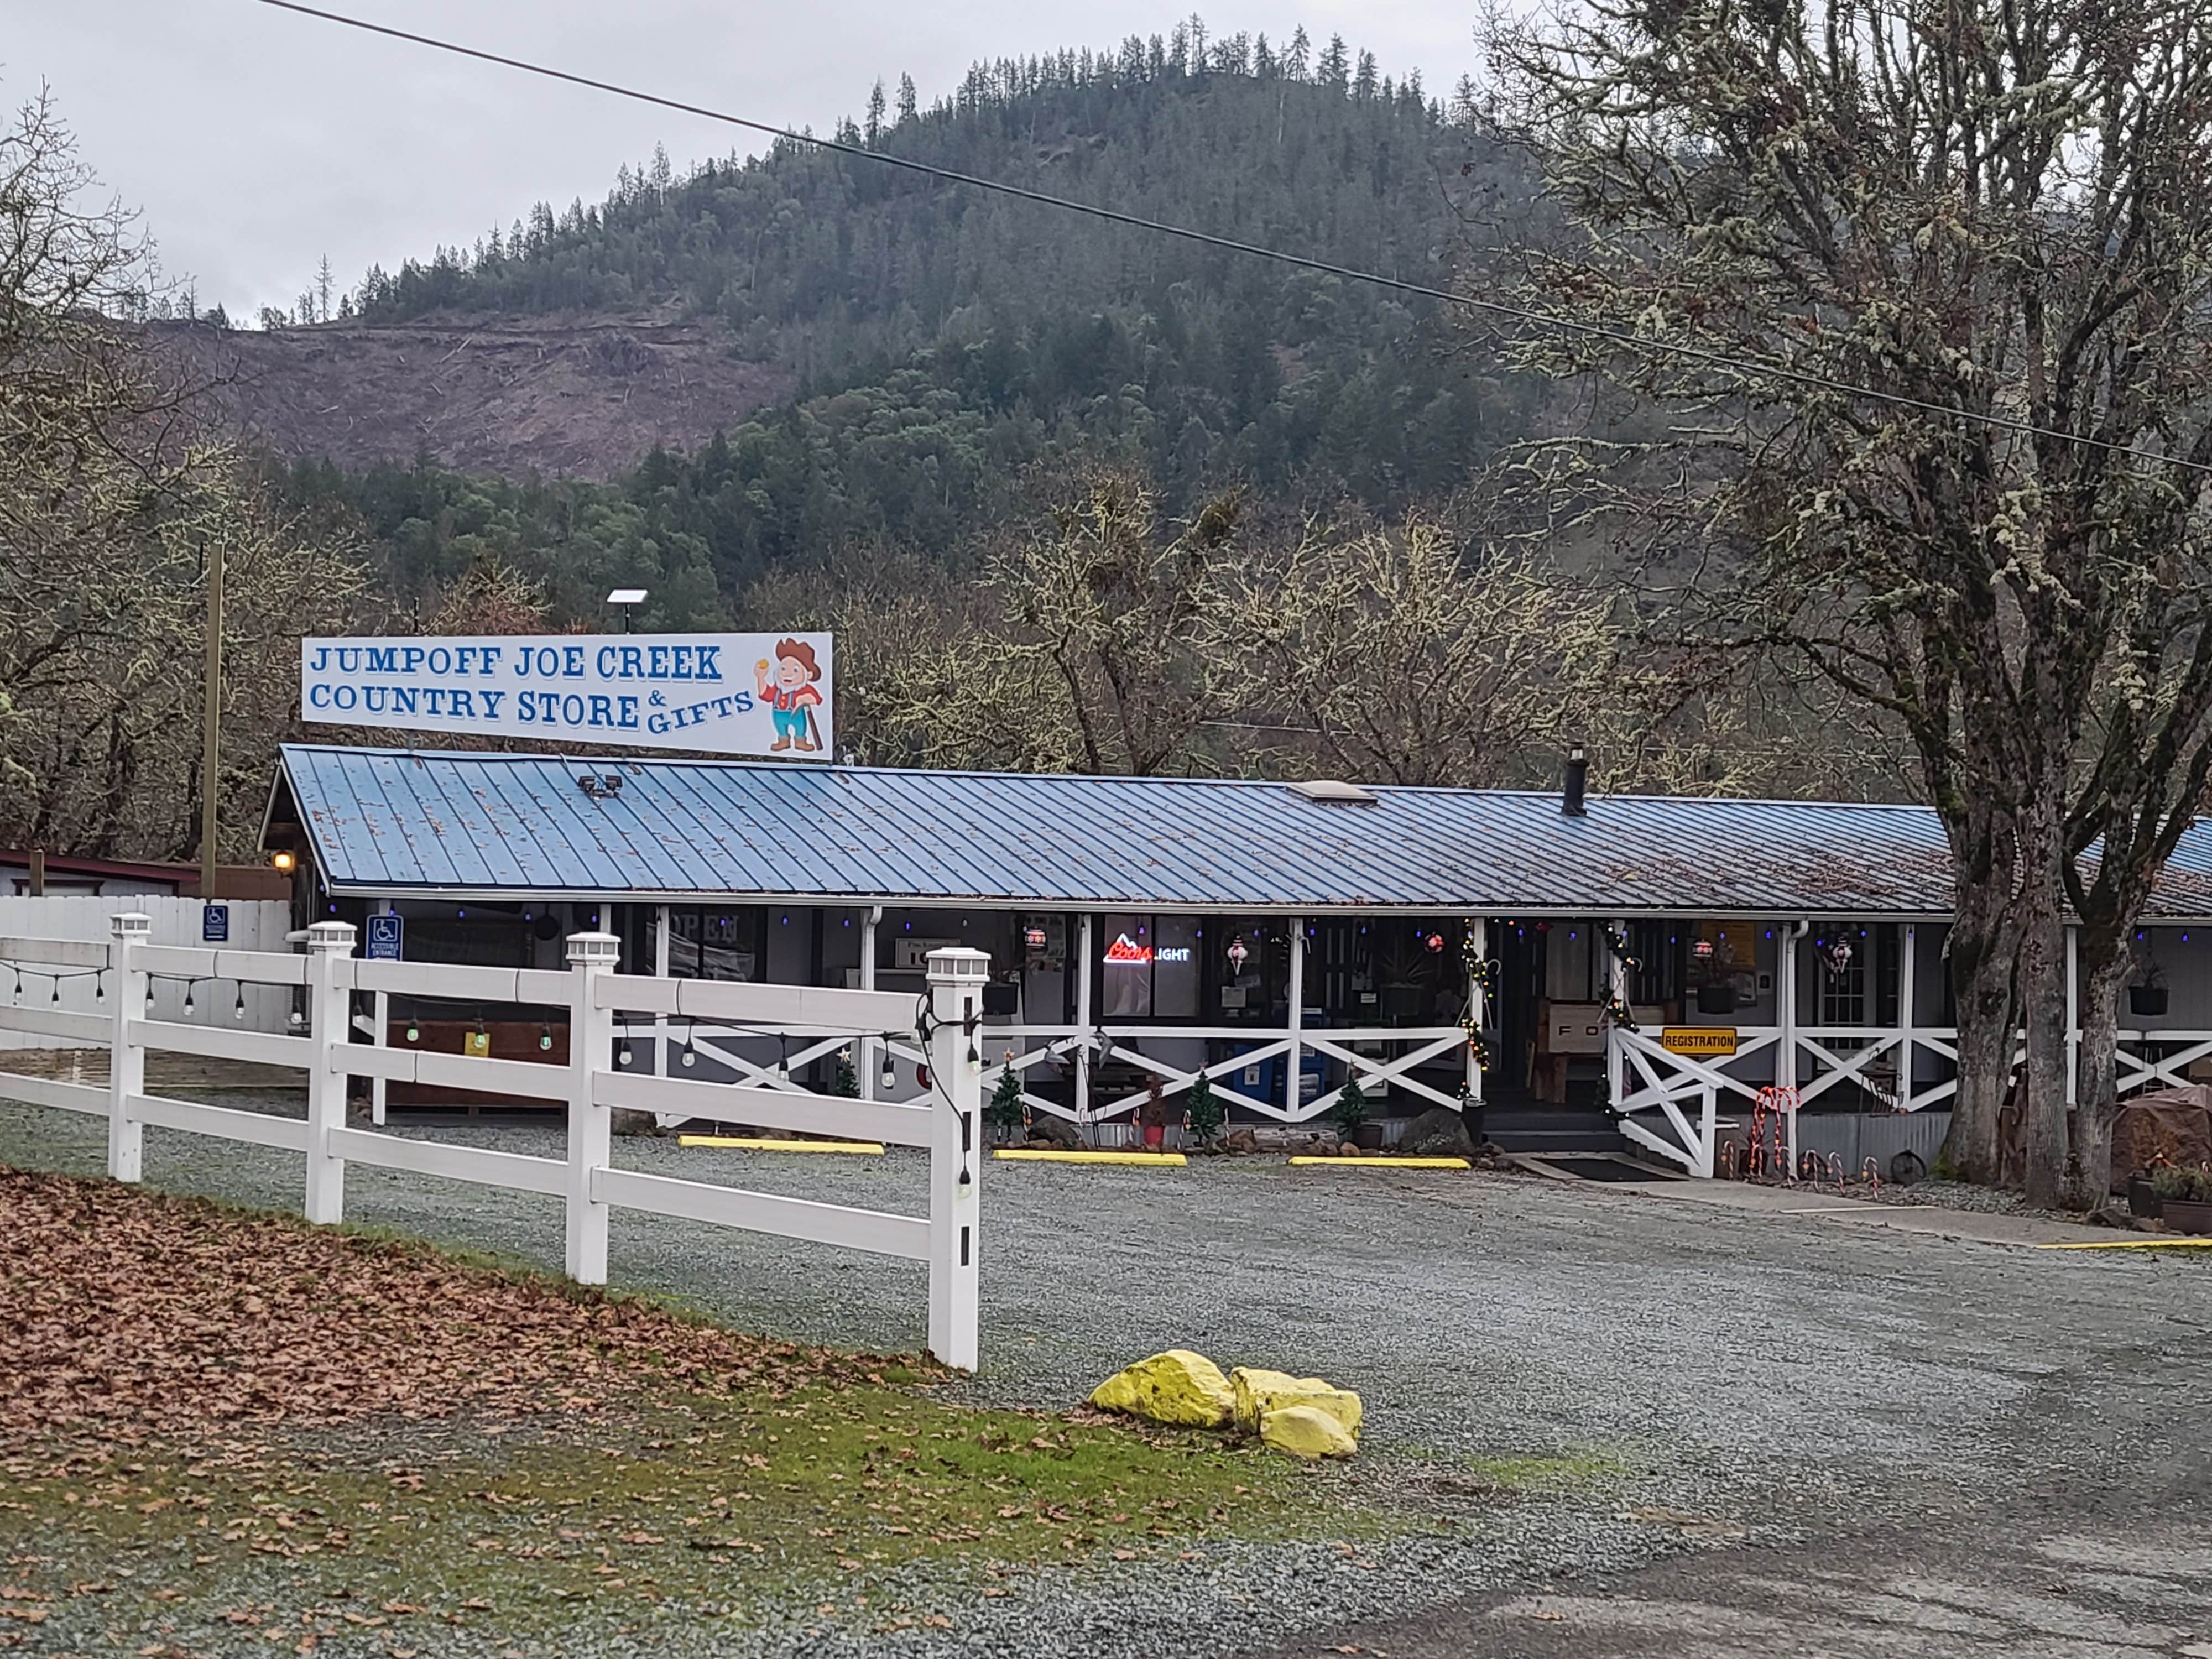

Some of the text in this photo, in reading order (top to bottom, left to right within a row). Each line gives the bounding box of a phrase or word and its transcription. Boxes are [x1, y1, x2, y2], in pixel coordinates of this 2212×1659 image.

[310, 646, 722, 680] JUMPOFF JOE CREEK
[310, 684, 754, 734] COUNTRY STORE & GIFTS
[1108, 941, 1152, 961] Coors
[1665, 1035, 1734, 1047] REGISTRATION
